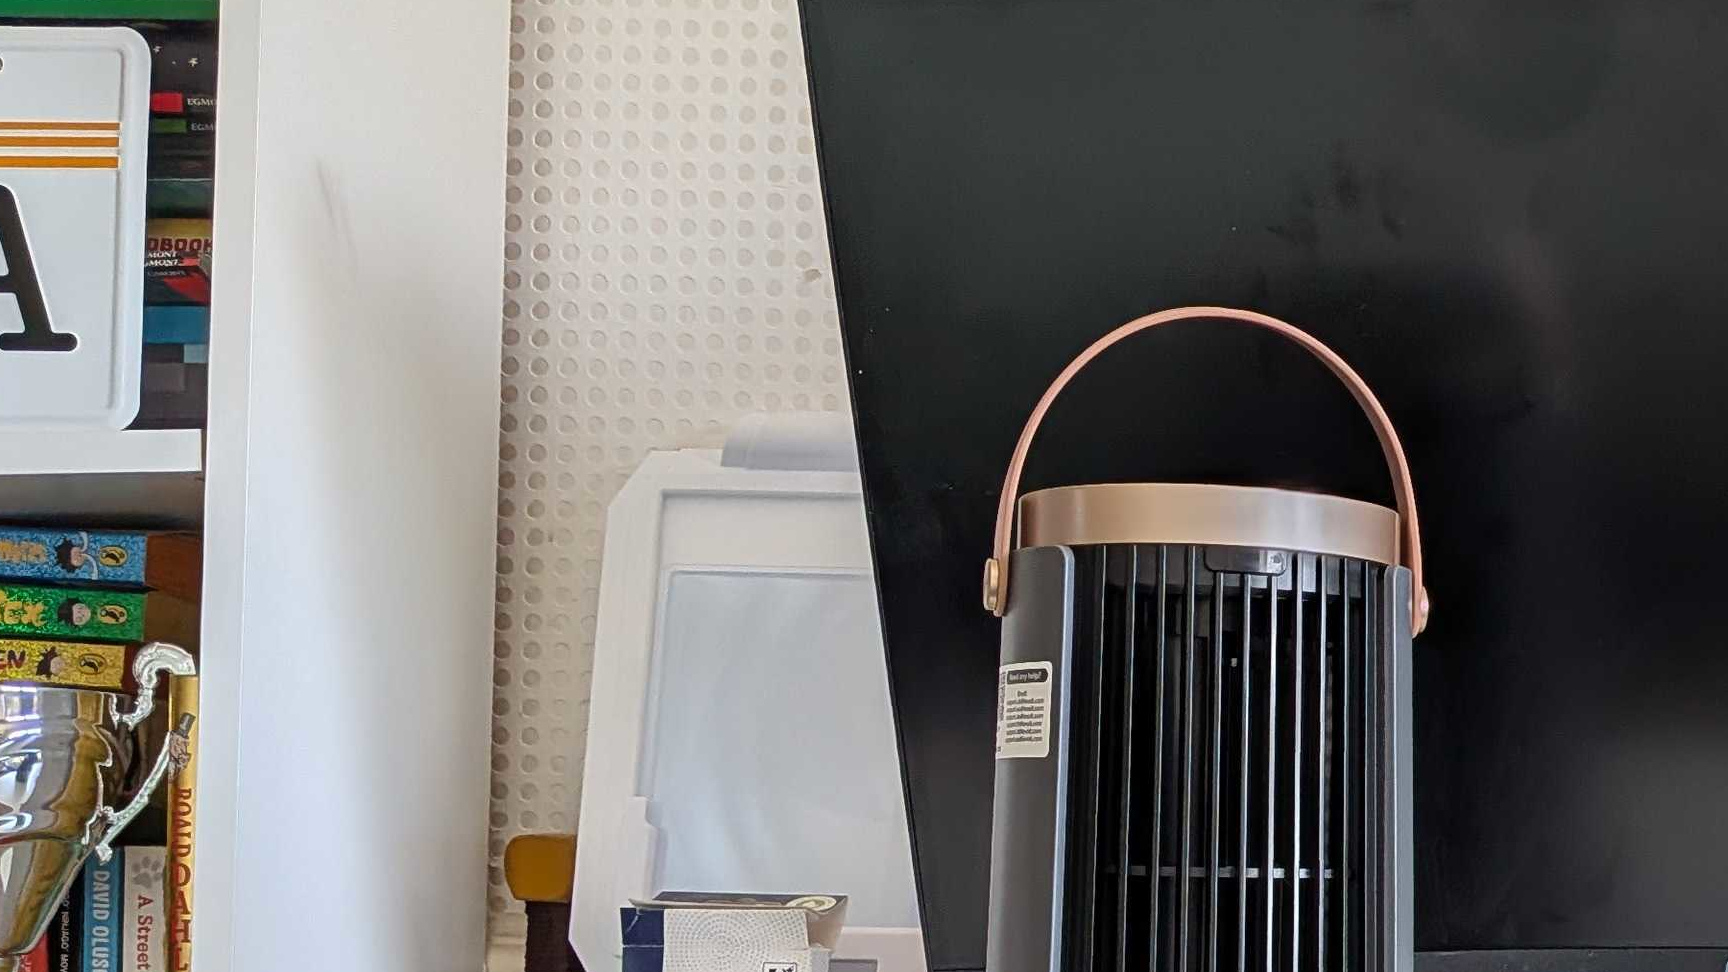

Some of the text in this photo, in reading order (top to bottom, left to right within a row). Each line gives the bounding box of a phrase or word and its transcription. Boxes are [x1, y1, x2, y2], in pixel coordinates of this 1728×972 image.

[92, 870, 111, 921] DAVID
[137, 894, 154, 910] A
[136, 914, 153, 971] Street
